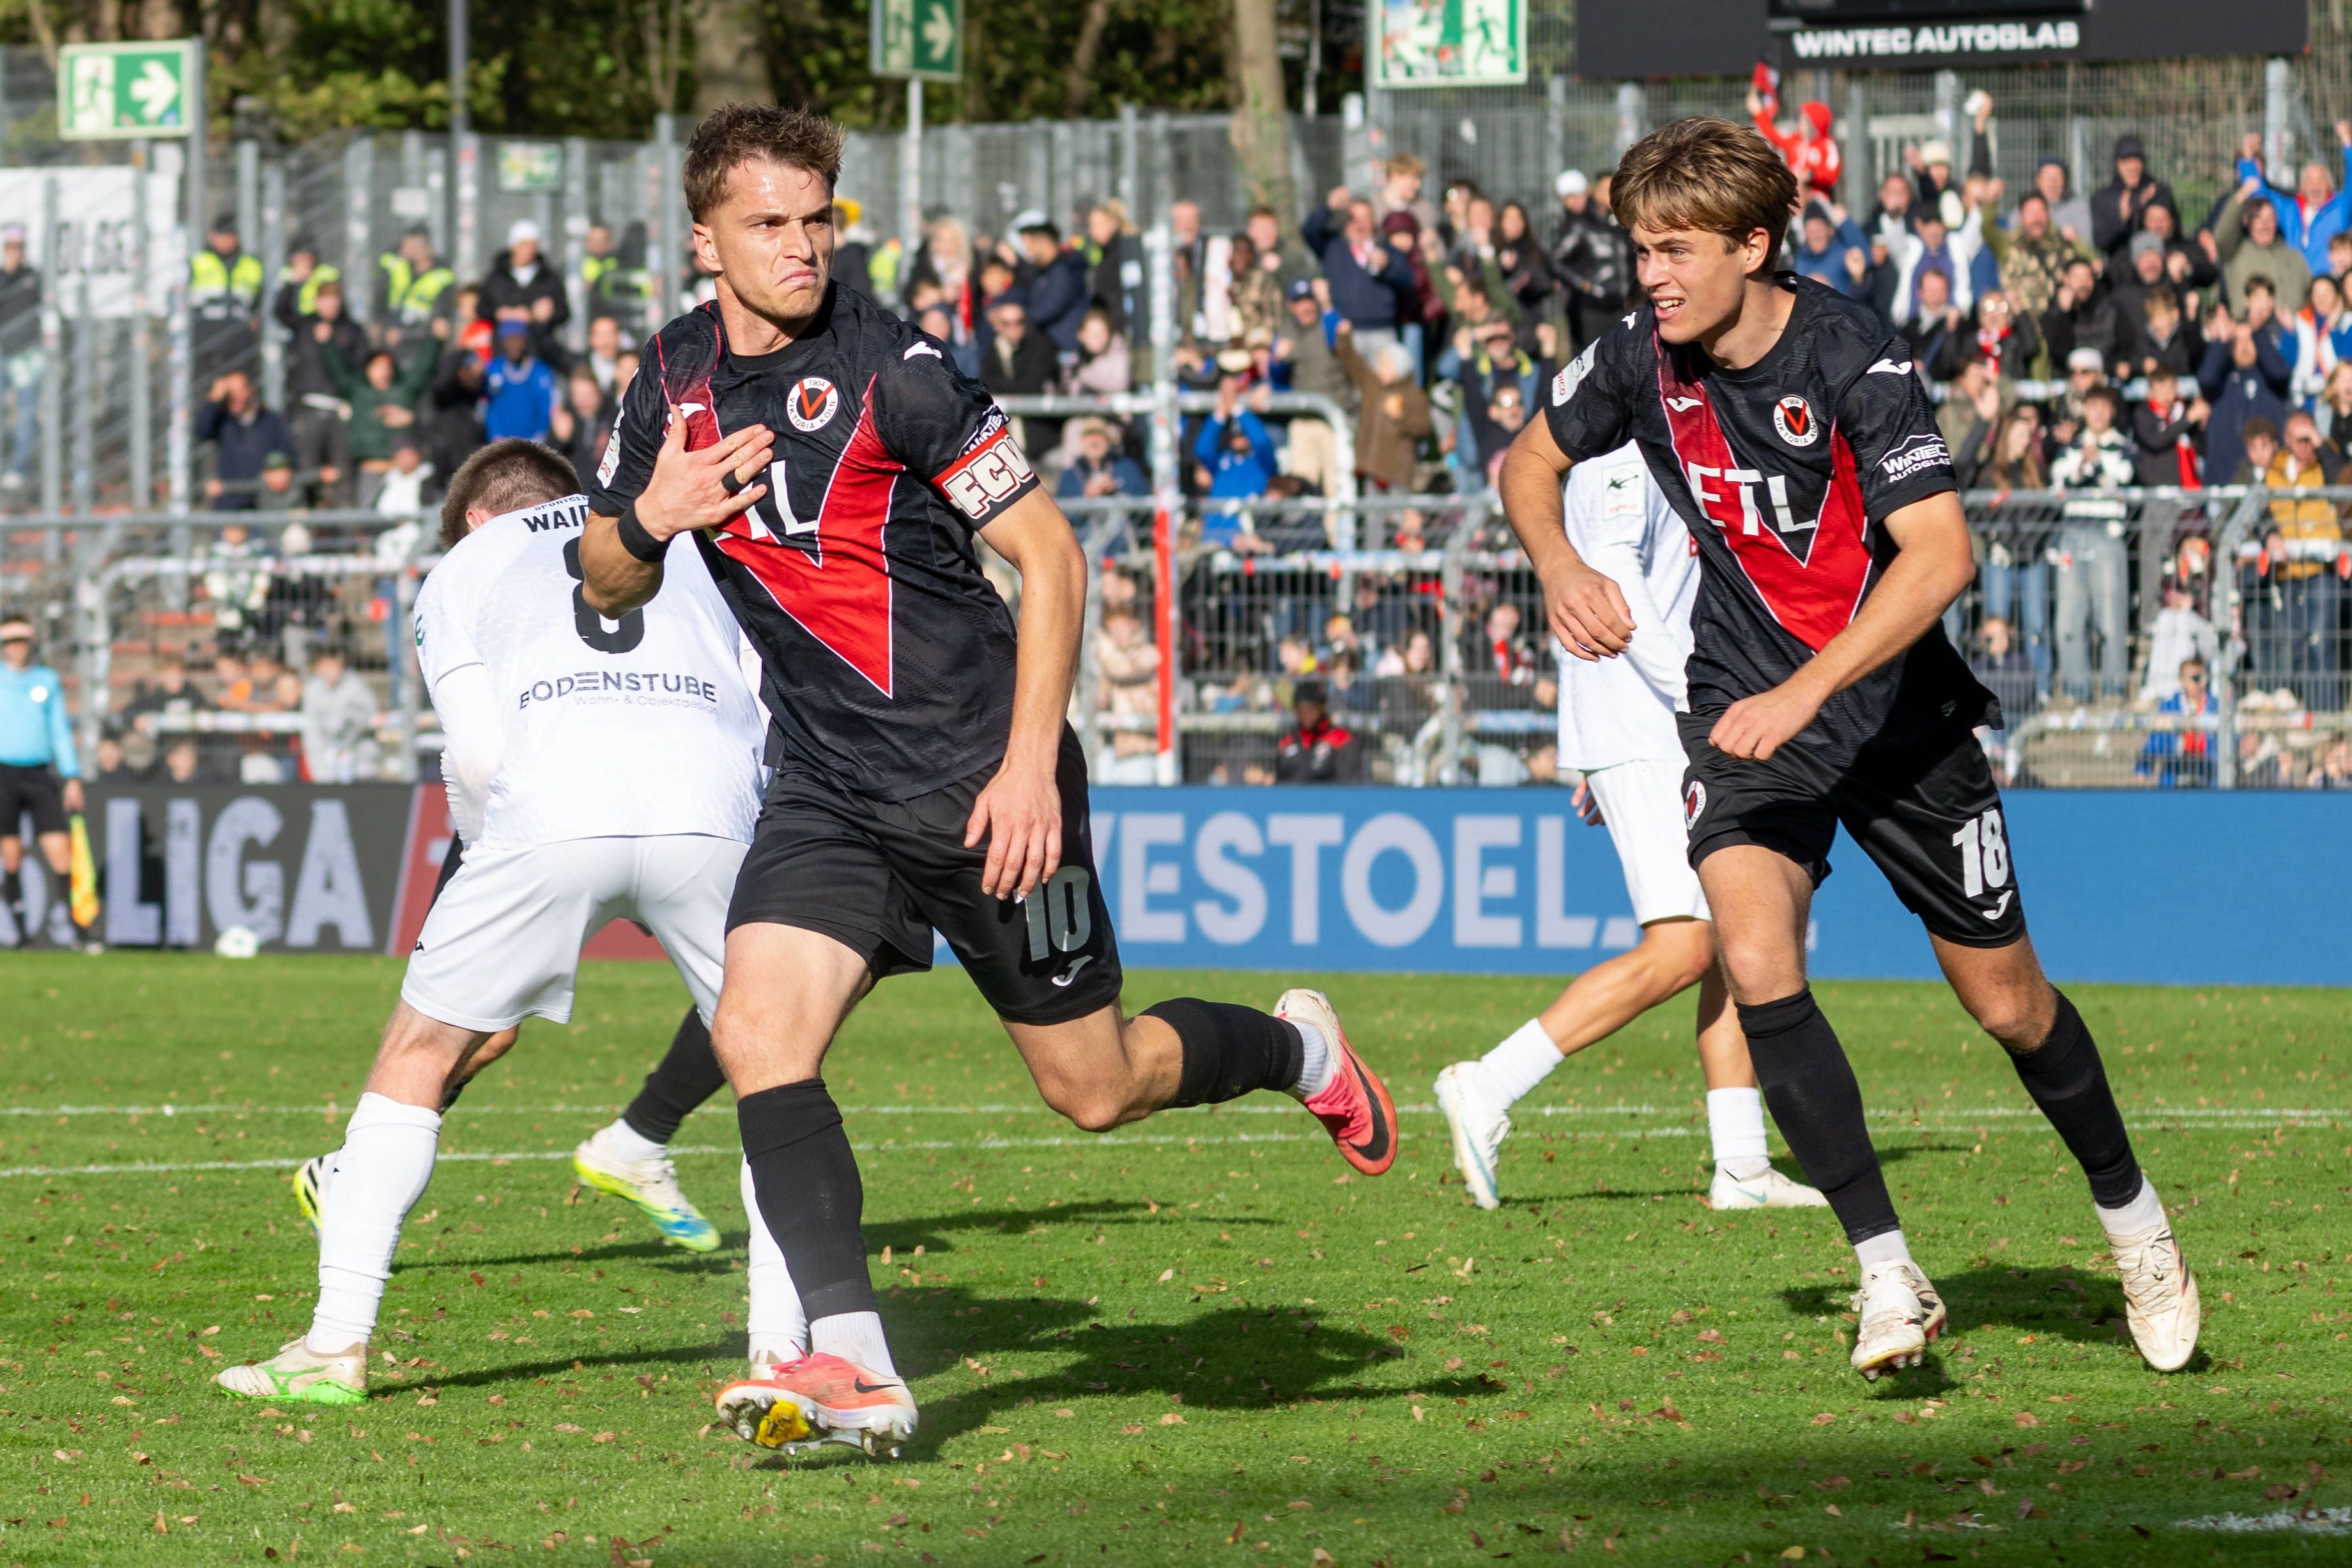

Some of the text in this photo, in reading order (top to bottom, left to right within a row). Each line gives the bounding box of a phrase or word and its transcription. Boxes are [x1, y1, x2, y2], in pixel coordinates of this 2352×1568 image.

[1792, 27, 1912, 58] WINTEC
[789, 397, 836, 429] VIKTORIA KÖLN
[1776, 417, 1808, 445] VIKTORIA
[1687, 461, 1817, 537] ETL
[105, 796, 374, 947] LIGA
[1952, 806, 2009, 898] 18
[1012, 865, 1091, 962] 10
